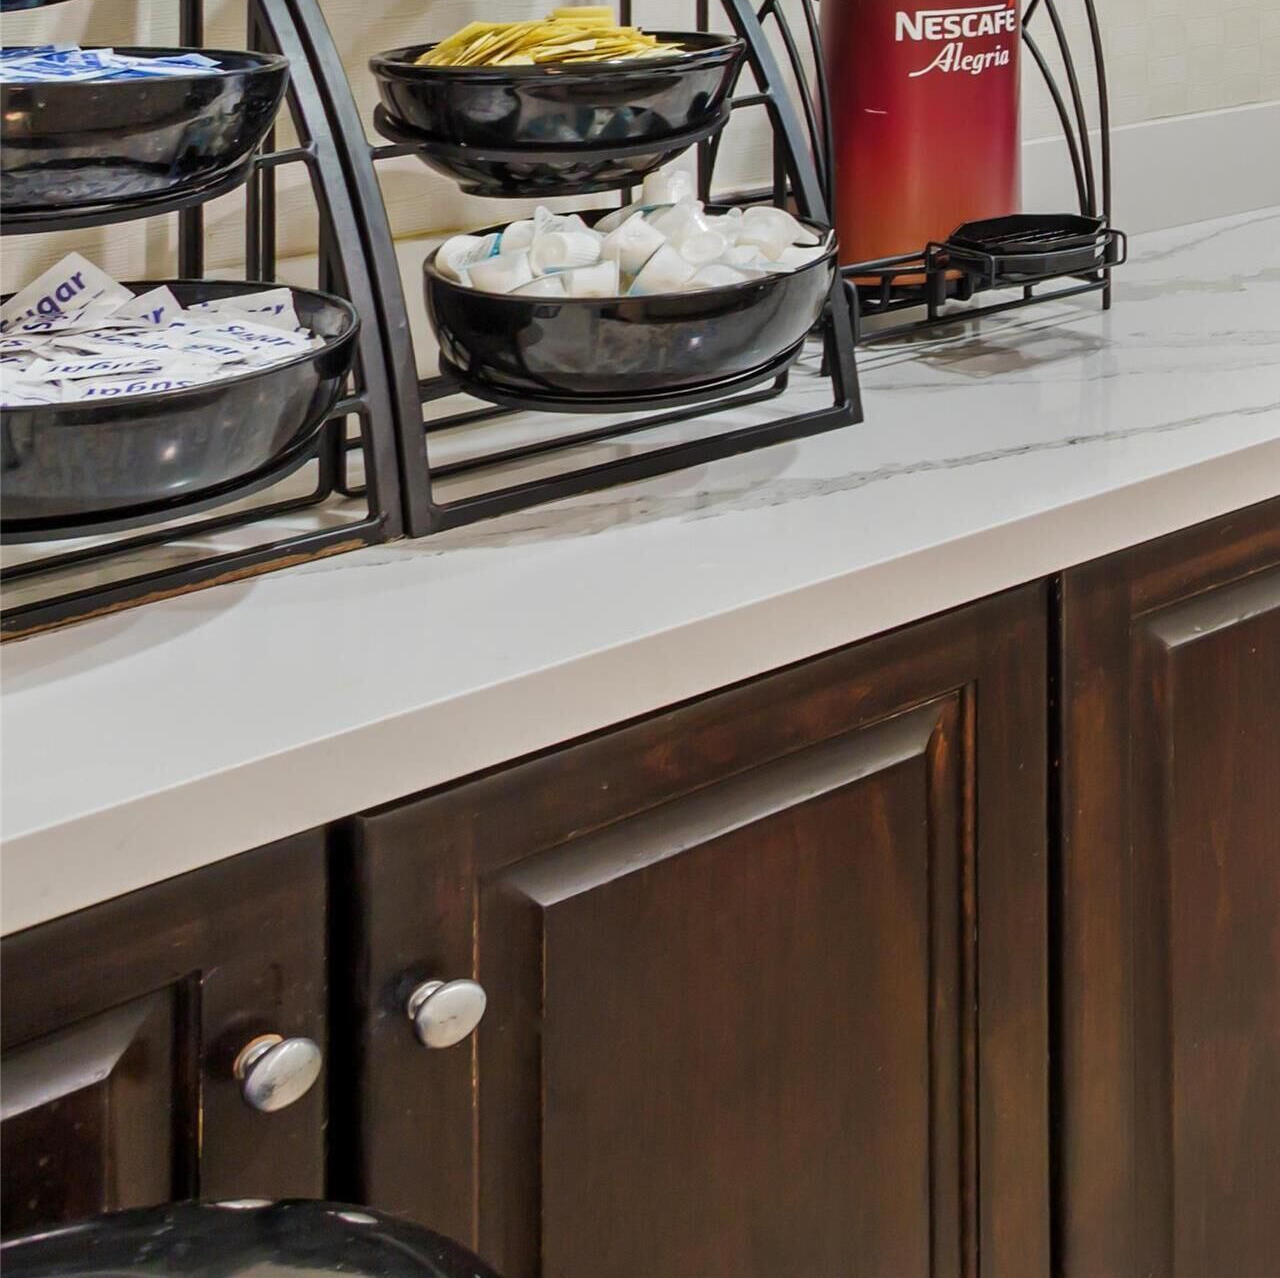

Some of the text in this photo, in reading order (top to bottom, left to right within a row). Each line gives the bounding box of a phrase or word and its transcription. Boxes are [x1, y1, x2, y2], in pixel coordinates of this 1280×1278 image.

[908, 42, 1010, 77] Alegria
[216, 325, 295, 347] Sugar
[82, 380, 197, 398] Sugar
